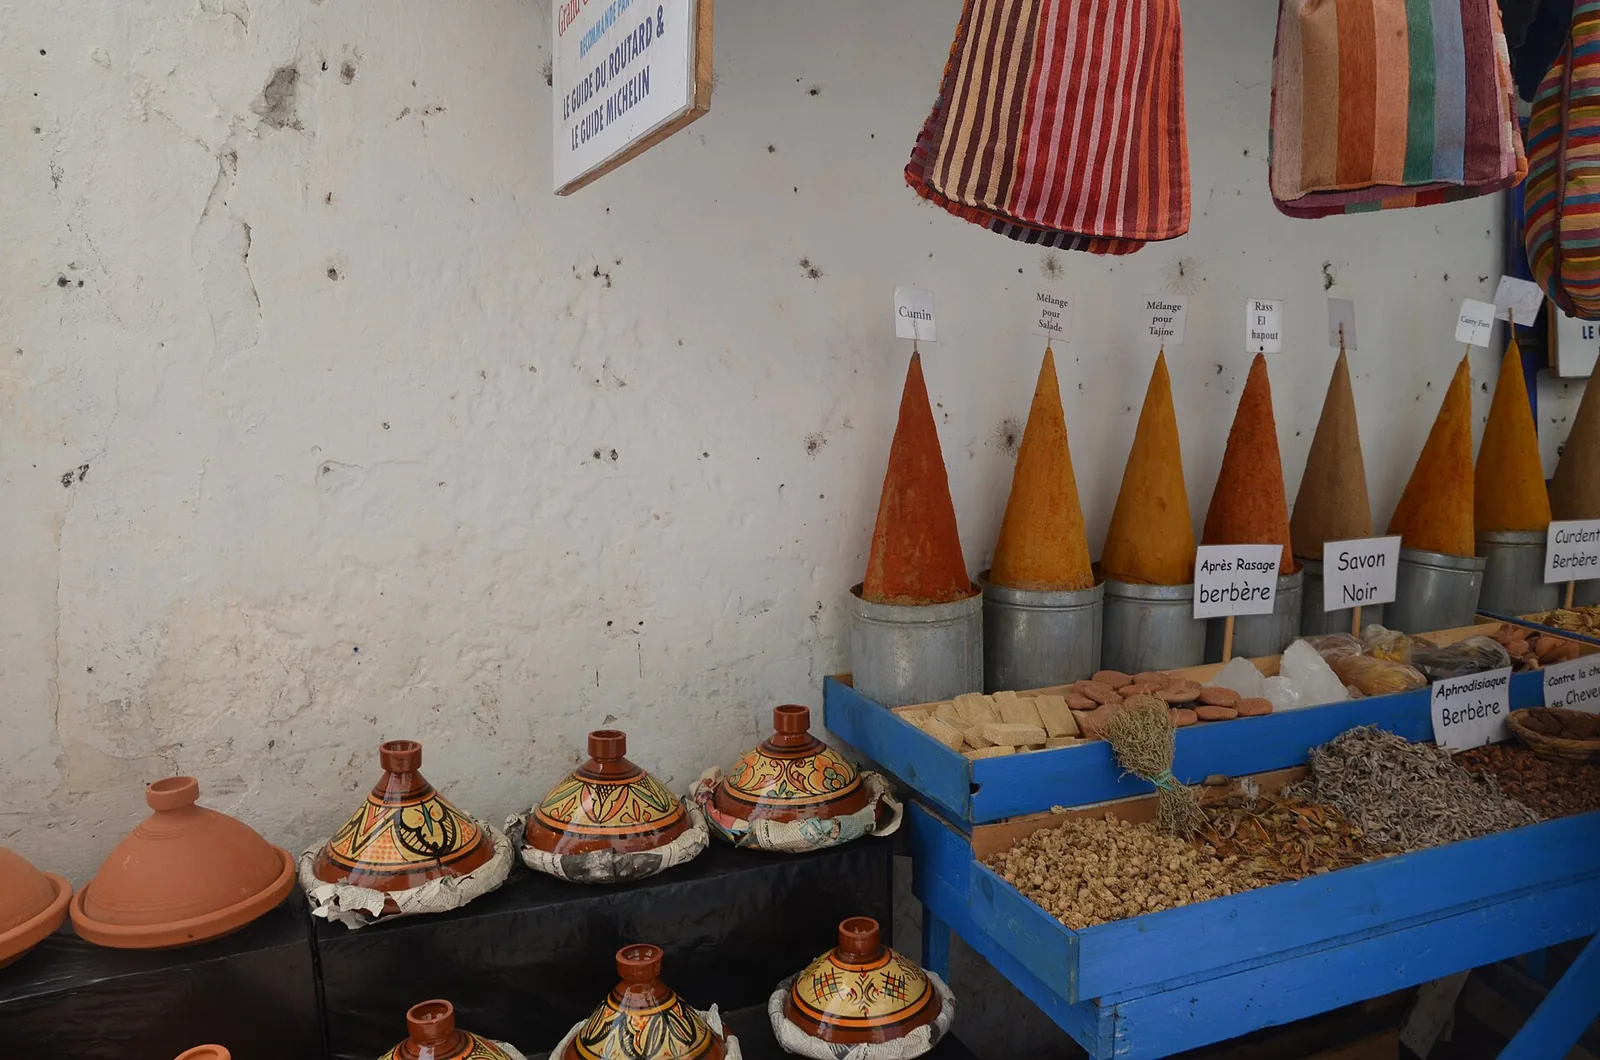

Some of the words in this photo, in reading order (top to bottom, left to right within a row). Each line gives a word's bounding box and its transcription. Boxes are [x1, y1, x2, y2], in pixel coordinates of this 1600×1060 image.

[563, 97, 570, 121] LE
[571, 72, 593, 114] GUIDE
[595, 60, 606, 93] DU
[609, 16, 653, 81] ROUTARD
[656, 4, 665, 38] &
[571, 125, 578, 151] LE
[580, 104, 604, 144] GUIDE
[606, 65, 650, 127] MICHELIN
[1036, 292, 1069, 309] Mélange
[1146, 301, 1182, 313] Mélange
[1255, 301, 1273, 311] Rass
[898, 305, 932, 321] Cumin
[1042, 309, 1061, 319] pour
[1152, 316, 1173, 325] pour
[1257, 315, 1266, 326] El
[1038, 319, 1063, 332] Salade
[1149, 326, 1174, 338] Tajine
[1582, 325, 1594, 340] LE
[1555, 527, 1600, 544] Curdent
[1200, 559, 1232, 575] Après
[1236, 558, 1275, 574] Rasage
[1337, 552, 1385, 571] Savon
[1552, 551, 1598, 569] Berbère
[1200, 581, 1271, 604] berbère
[1343, 583, 1378, 604] Noir
[1548, 674, 1576, 687] Contre
[1579, 669, 1586, 680] la
[1436, 674, 1507, 700] Aphrodisiaque
[1551, 700, 1564, 709] des
[1566, 687, 1600, 705] Cheve
[1442, 700, 1501, 727] Berbère
